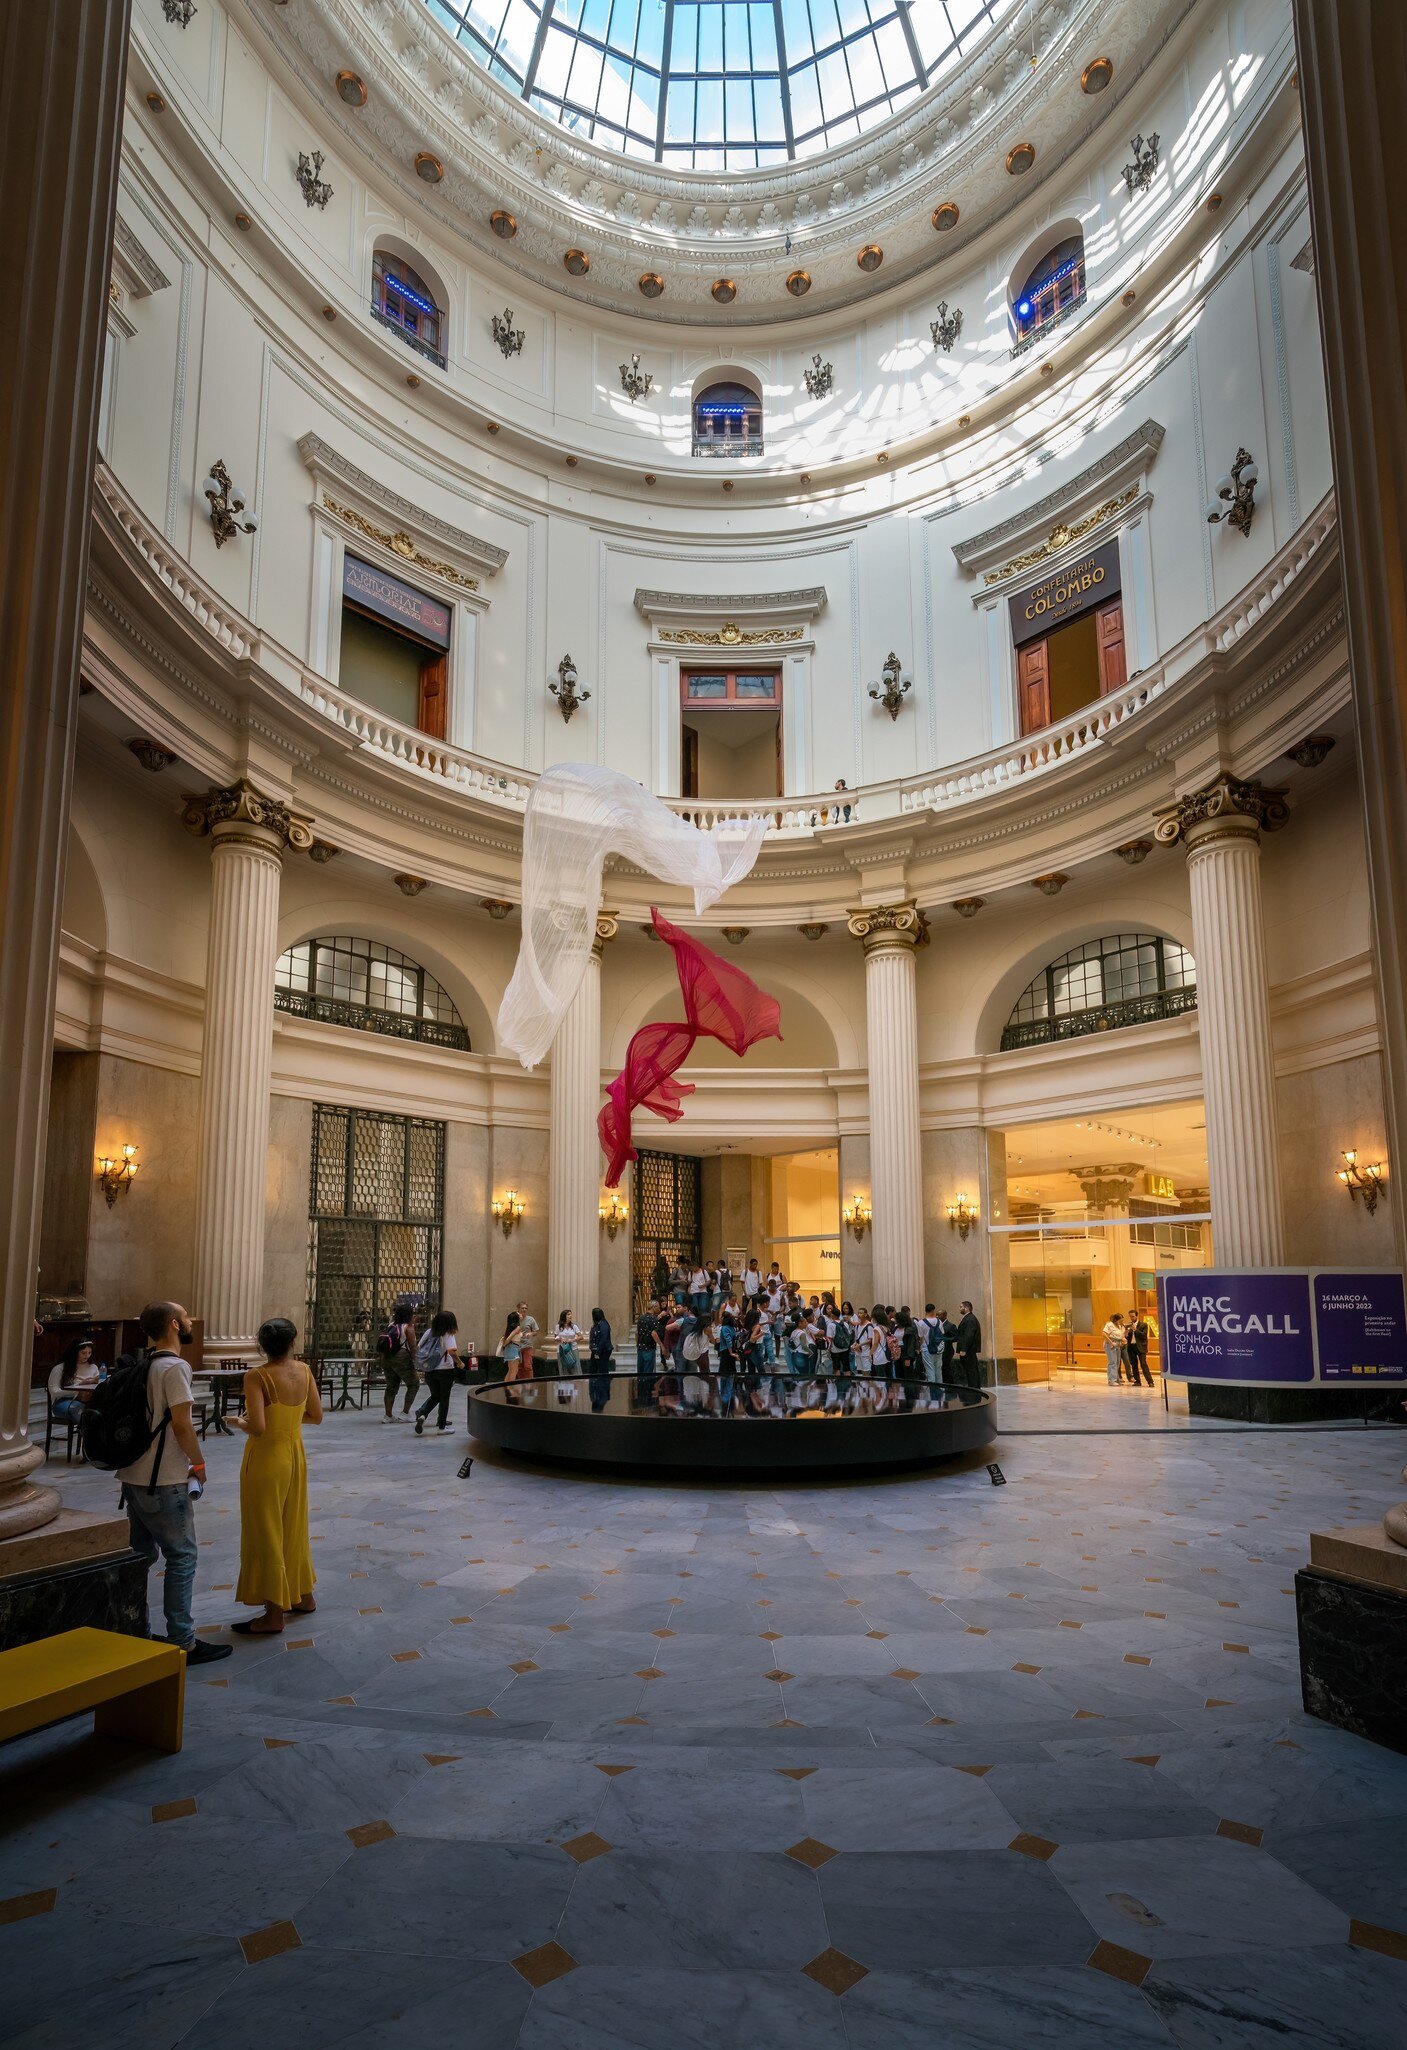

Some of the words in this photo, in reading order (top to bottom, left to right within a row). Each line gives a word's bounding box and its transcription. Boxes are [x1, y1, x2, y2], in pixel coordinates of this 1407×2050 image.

[1030, 558, 1096, 600] CONFEITARIA
[1025, 566, 1105, 620] COLOMBO
[1151, 1175, 1175, 1198] LAB
[1172, 1295, 1232, 1313] MARC
[1331, 1294, 1361, 1303] MARÇO
[1172, 1312, 1300, 1334] CHAGALL
[1174, 1333, 1211, 1345] SONHO
[1175, 1343, 1187, 1354] DE
[1188, 1345, 1223, 1356] AMOR
